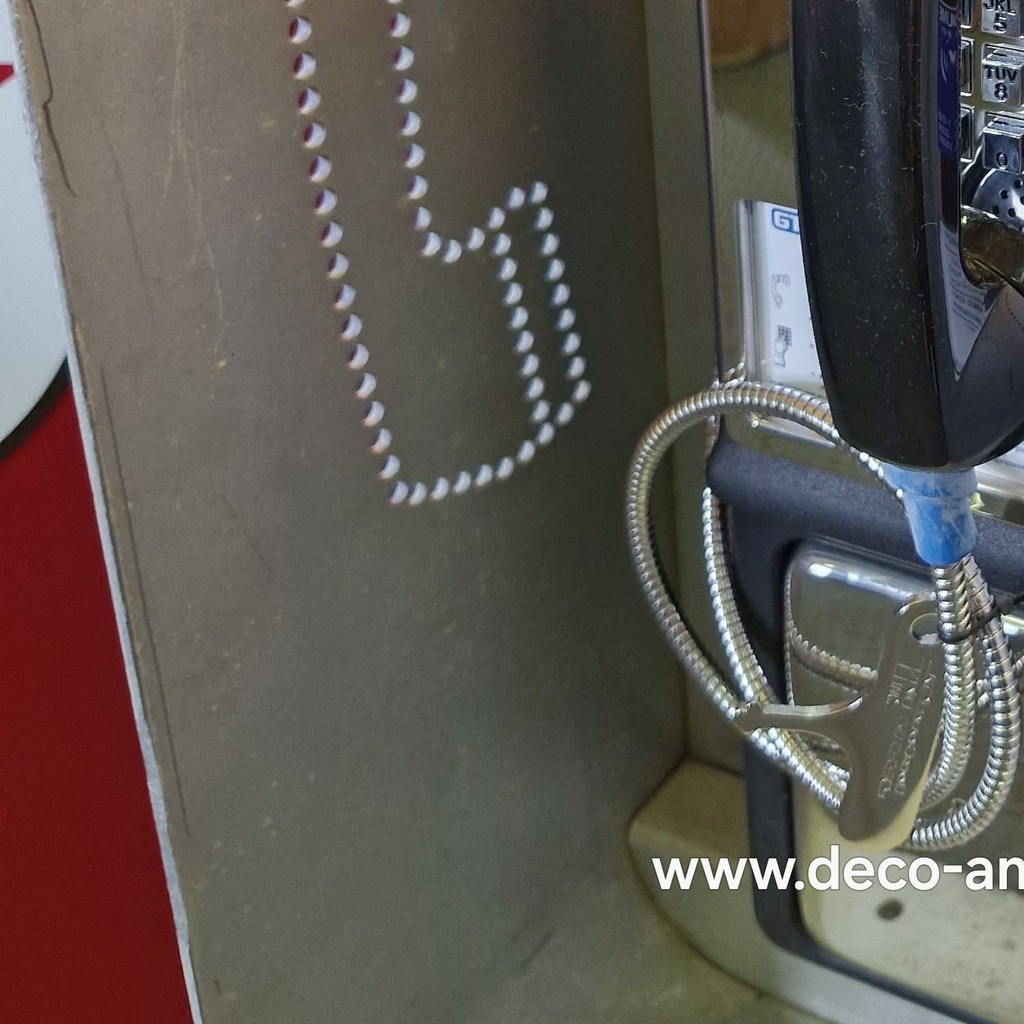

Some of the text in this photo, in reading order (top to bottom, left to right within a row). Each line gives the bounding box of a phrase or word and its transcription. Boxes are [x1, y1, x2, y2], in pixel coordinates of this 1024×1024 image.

[993, 11, 1007, 34] 5
[983, 64, 1018, 84] TUV
[994, 82, 1008, 103] 8
[996, 151, 1009, 170] 0
[773, 210, 800, 233] GT
